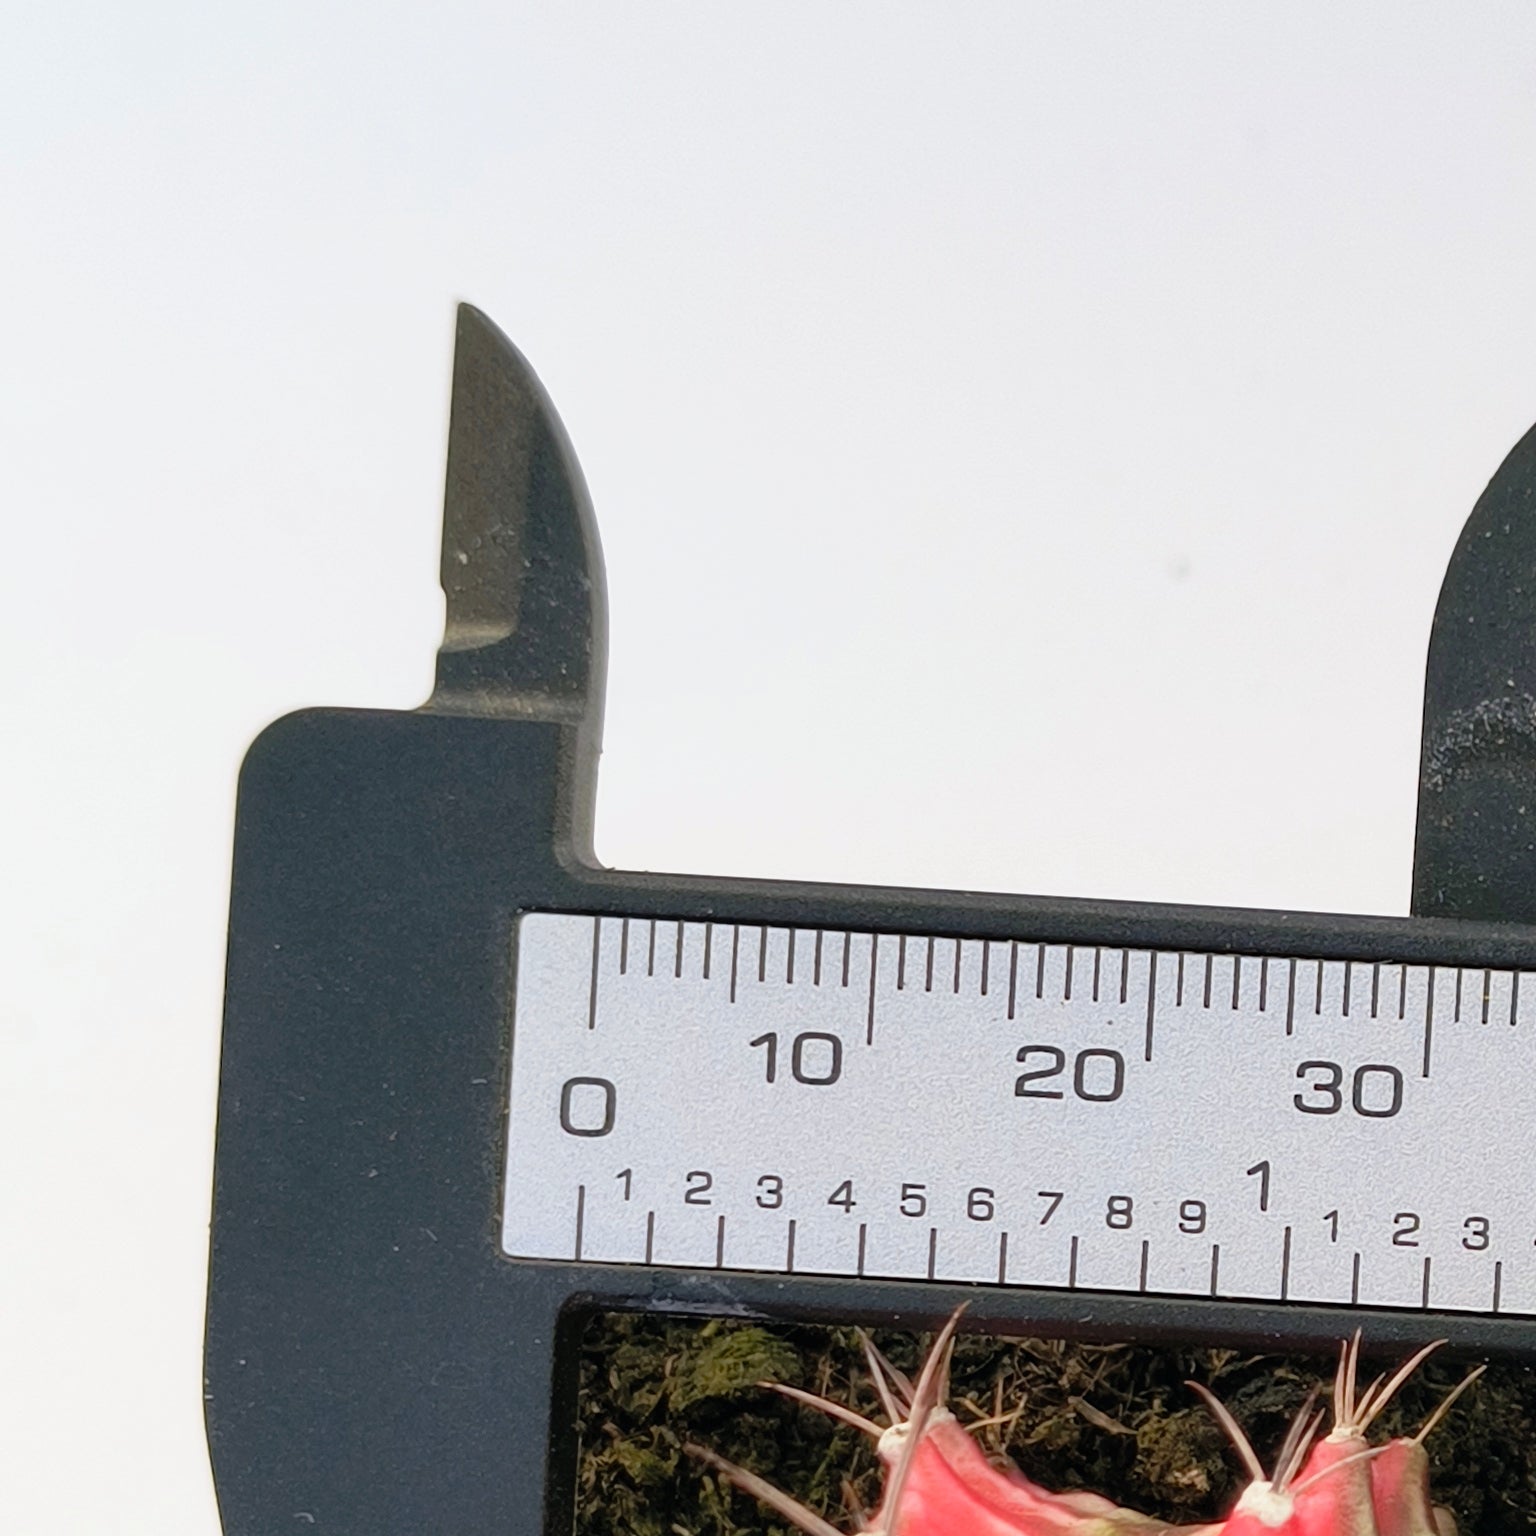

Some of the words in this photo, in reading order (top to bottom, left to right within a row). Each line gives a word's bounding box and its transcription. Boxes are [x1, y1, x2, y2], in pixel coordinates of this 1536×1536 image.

[560, 1077, 617, 1138] 0
[749, 1032, 843, 1086] 10
[1014, 1045, 1125, 1103] 20
[1293, 1061, 1404, 1119] 30
[616, 1169, 632, 1201] 1
[685, 1171, 713, 1206] 2
[756, 1175, 783, 1210] 3
[828, 1180, 857, 1214] 4
[899, 1183, 927, 1218] 5
[968, 1188, 995, 1222] 6
[1037, 1192, 1064, 1226] 7
[1106, 1196, 1134, 1230] 8
[1179, 1200, 1207, 1234] 9
[1246, 1161, 1270, 1212] 1
[1322, 1210, 1339, 1243] 1
[1393, 1213, 1420, 1248] 2
[1462, 1217, 1490, 1251] 3
